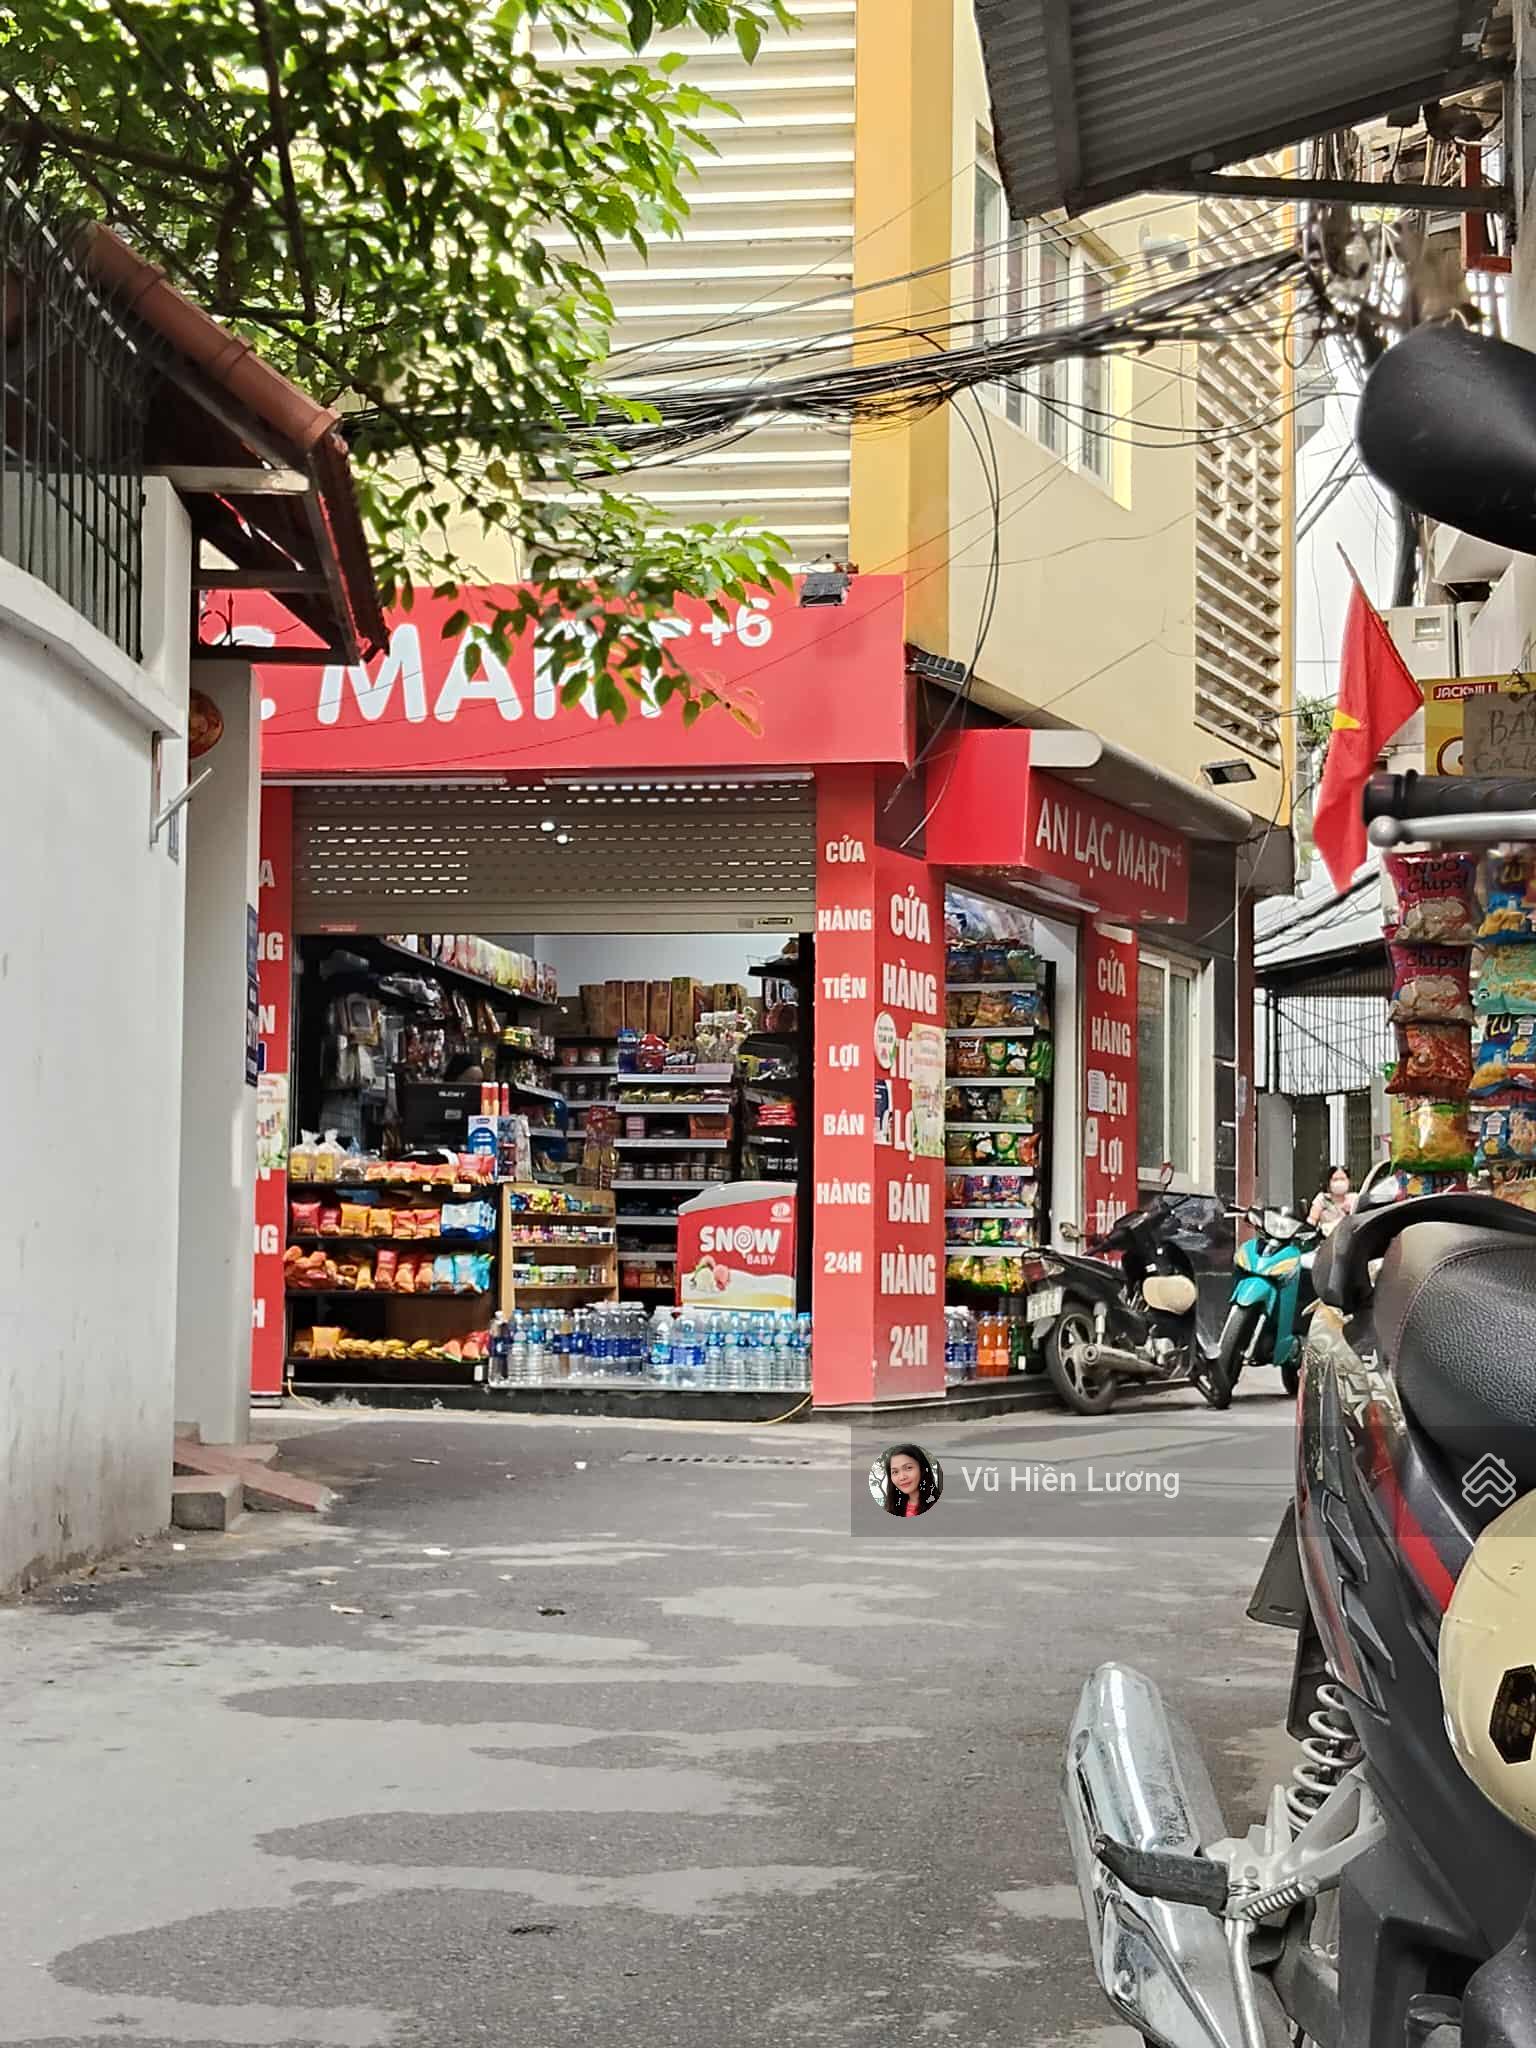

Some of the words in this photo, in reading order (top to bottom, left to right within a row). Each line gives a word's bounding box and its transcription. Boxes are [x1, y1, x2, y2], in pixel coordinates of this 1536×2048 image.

[825, 834, 866, 863] CỬA
[1035, 797, 1069, 856] AN
[1074, 810, 1113, 879] LẠC
[1117, 829, 1170, 893] MART
[817, 905, 872, 931] HÀNG
[890, 885, 931, 944] CỬA
[822, 973, 867, 1003] TIỆN
[881, 958, 937, 1015] HÀNG
[1097, 949, 1127, 997] CỬA
[1091, 1012, 1131, 1058] HÀNG
[828, 1044, 860, 1071] LỢI
[1104, 1072, 1128, 1123] IỆN
[823, 1109, 865, 1136] BÁN
[1100, 1136, 1123, 1182] LỢI
[816, 1178, 871, 1205] HÀNG
[888, 1174, 930, 1224] BÁN
[700, 1225, 781, 1256] SNOW
[746, 1254, 776, 1266] BABY
[824, 1252, 862, 1274] 24H
[881, 1244, 936, 1295] HÀNG
[889, 1325, 928, 1367] 24H
